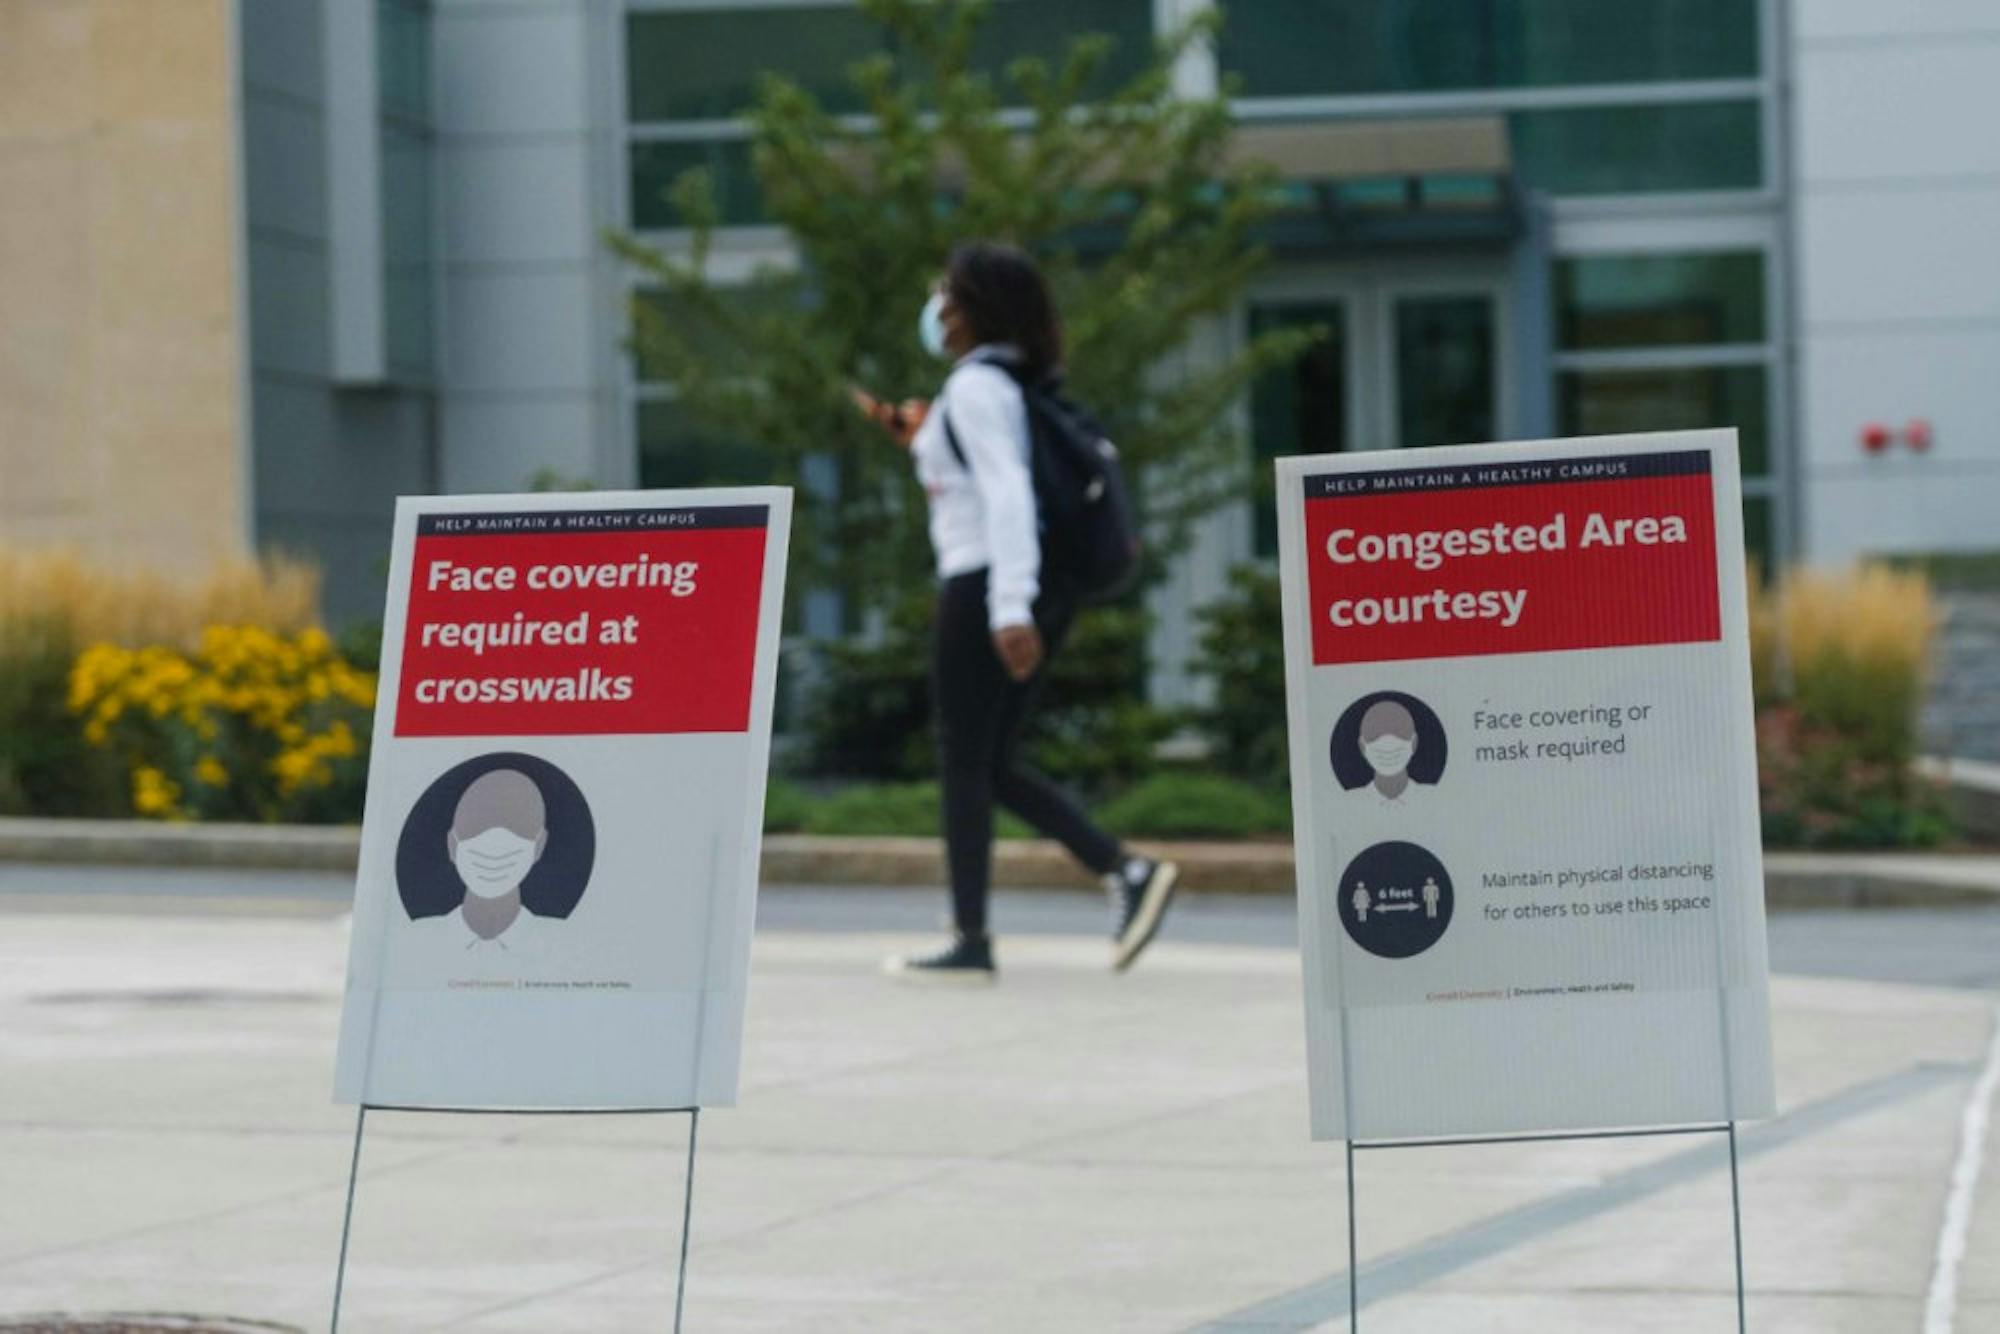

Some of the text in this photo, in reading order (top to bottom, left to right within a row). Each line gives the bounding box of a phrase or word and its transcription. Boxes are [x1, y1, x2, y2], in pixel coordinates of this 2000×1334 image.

[1325, 462, 1628, 492] HELP MAINTAIN A HEALTHY CAMPUS
[435, 513, 696, 531] HELP MAINTAIN A HEALTHY CAMPUS
[1326, 512, 1687, 570] Congested Area
[427, 554, 698, 597] Face covering
[1329, 588, 1528, 627] courtesy
[421, 612, 639, 655] required at
[415, 668, 633, 704] crosswalks
[1473, 704, 1652, 730] Face covering or
[1475, 734, 1626, 763] mask required
[1482, 862, 1715, 888] Maintain physical distancing
[1388, 886, 1414, 899] feet
[1484, 896, 1711, 921] for others to use this space
